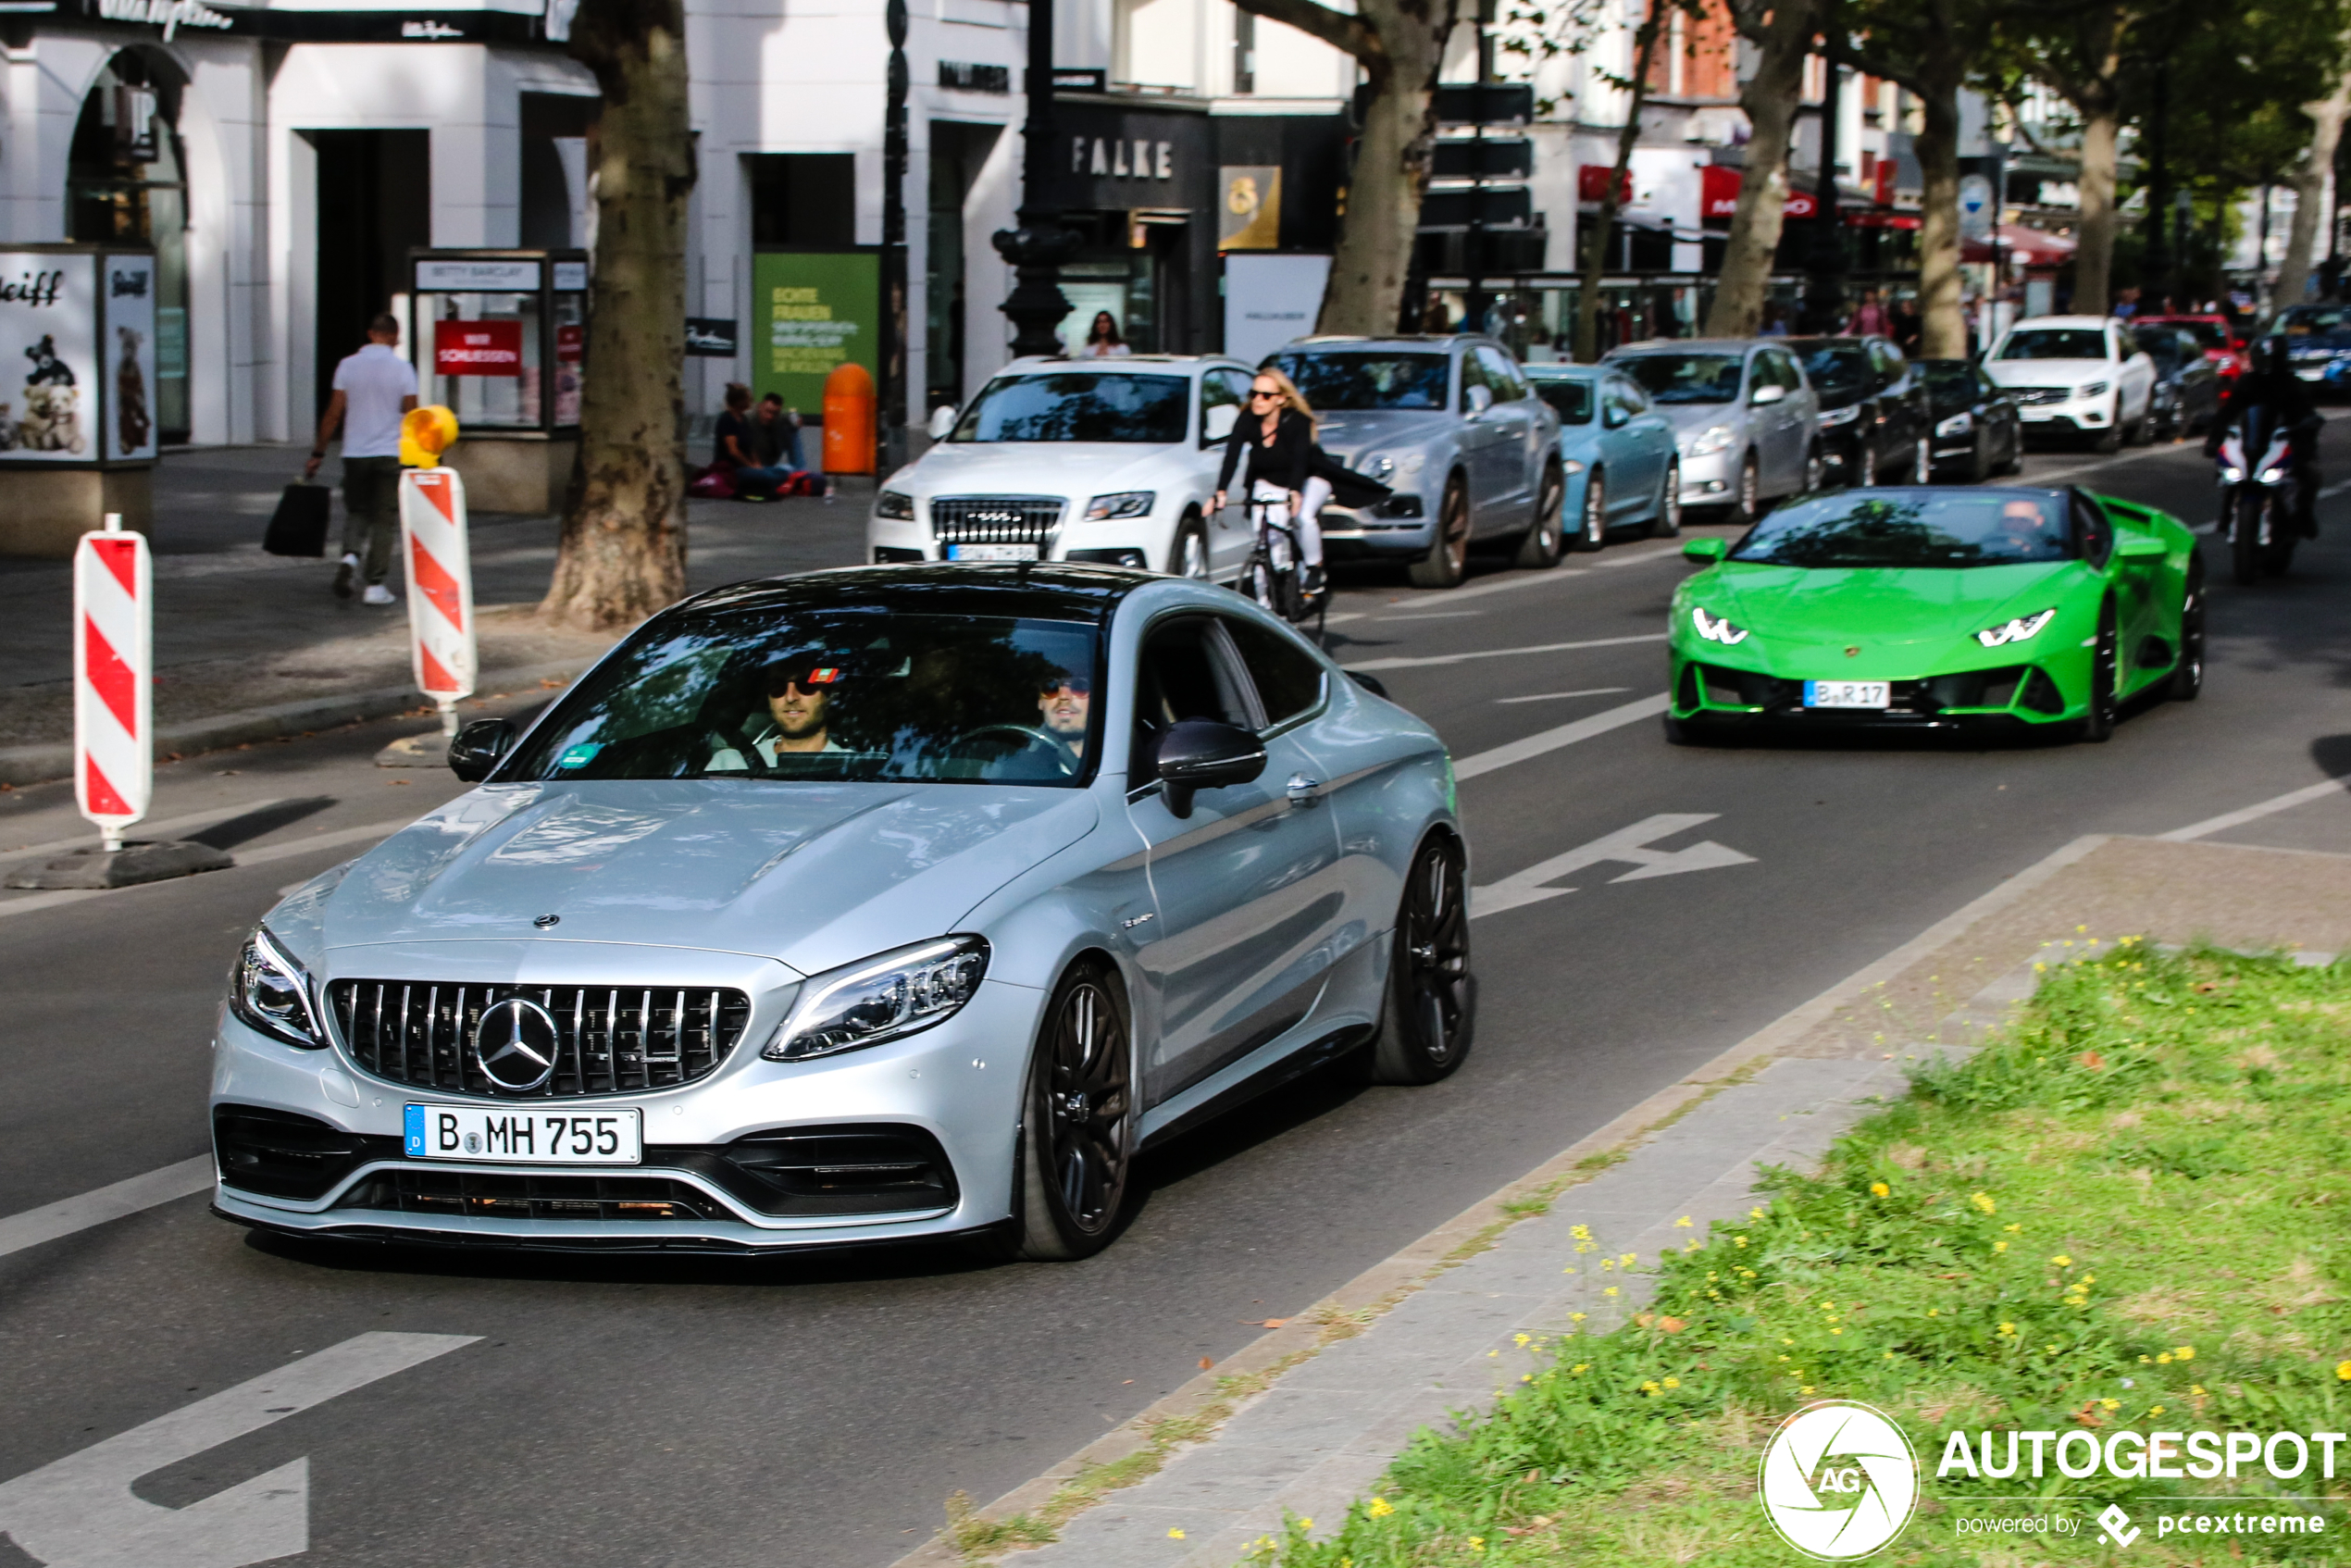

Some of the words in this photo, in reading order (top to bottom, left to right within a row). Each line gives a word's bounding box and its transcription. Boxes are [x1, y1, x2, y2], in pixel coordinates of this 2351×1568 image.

[1072, 137, 1172, 179] FALKE
[772, 287, 817, 304] ECHTE
[772, 305, 831, 320] FRAUEN
[464, 333, 491, 345] WIR
[439, 350, 516, 362] SCHLIESSEN
[1817, 686, 1830, 703] B
[1843, 686, 1855, 703] R
[1860, 686, 1884, 703] 17
[412, 1136, 421, 1147] D
[439, 1114, 460, 1151] B
[486, 1115, 534, 1154] MH
[546, 1117, 618, 1155] 755
